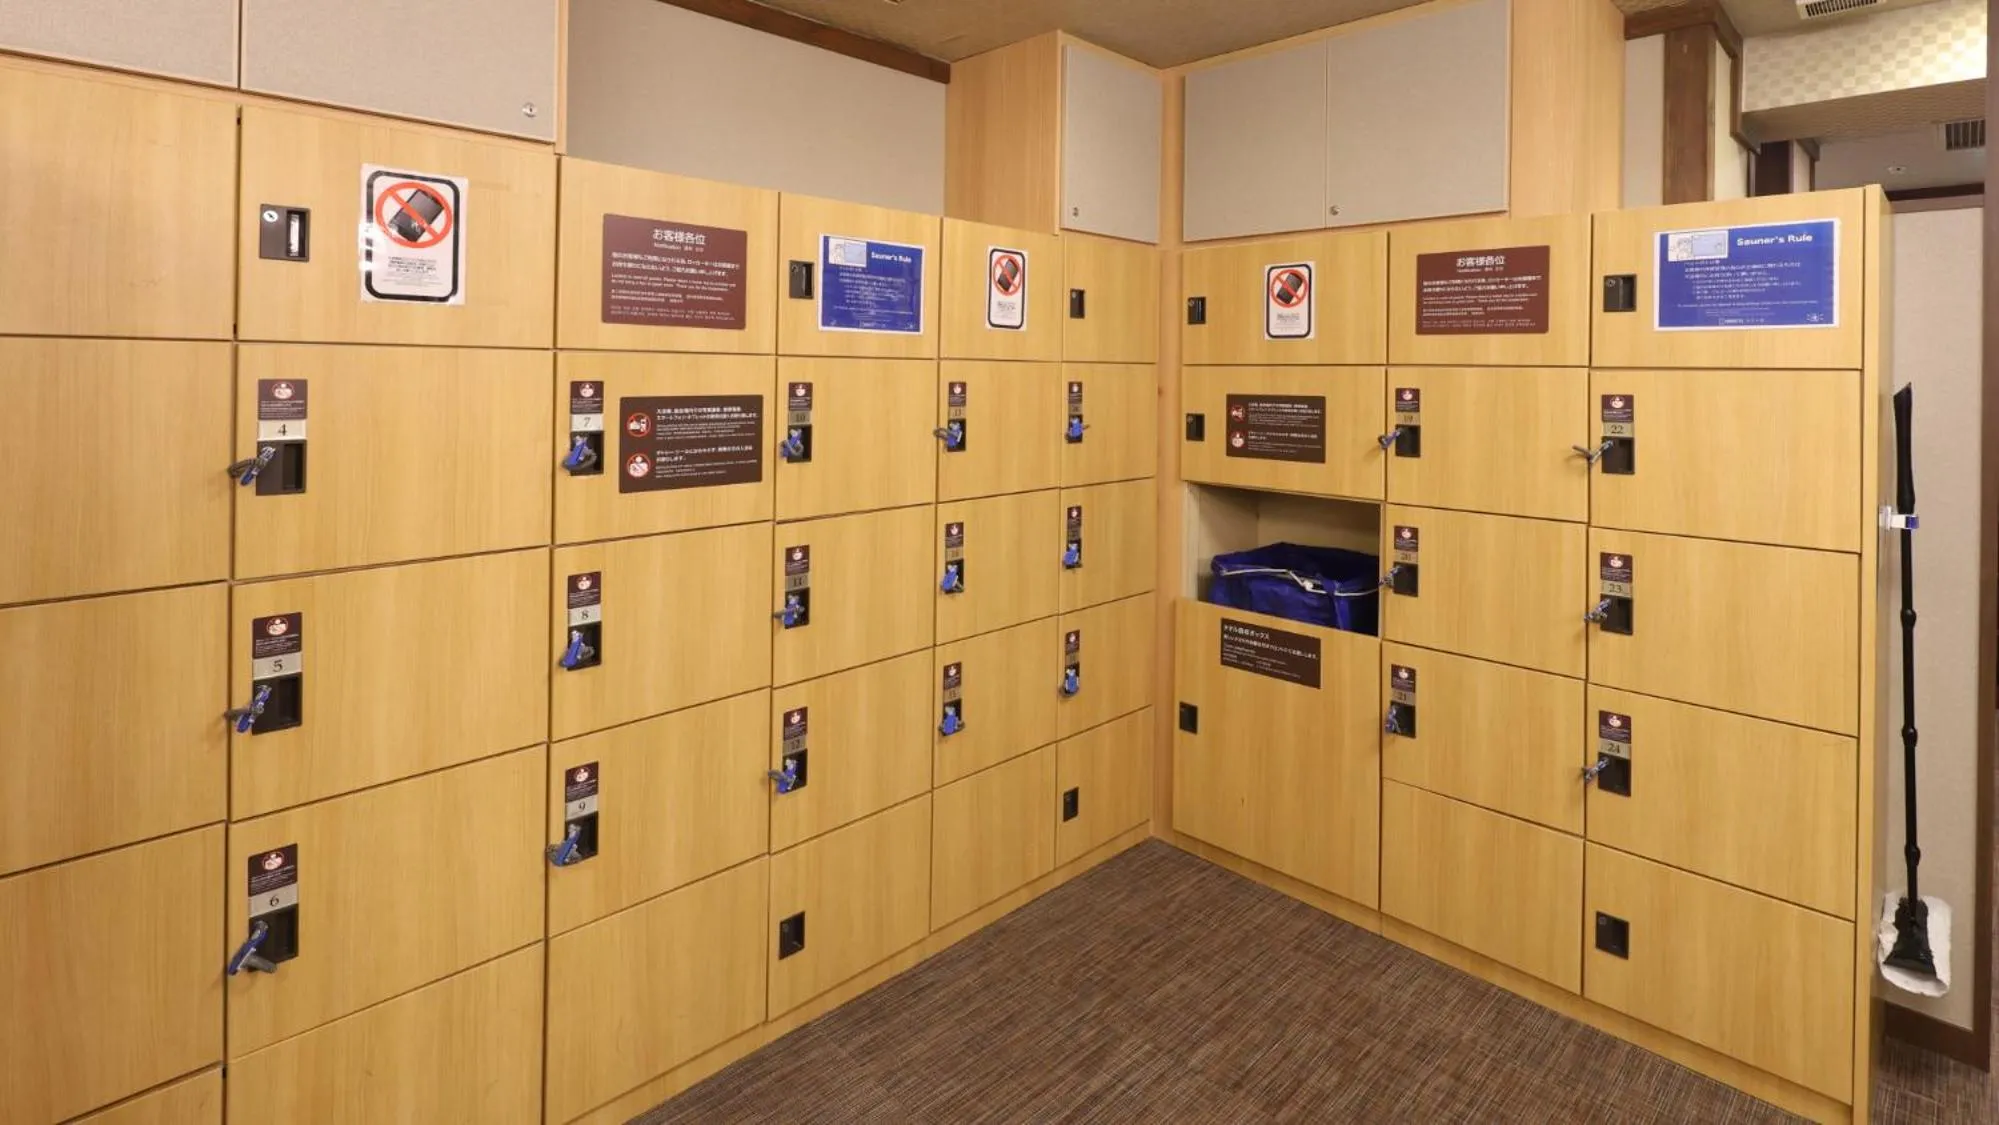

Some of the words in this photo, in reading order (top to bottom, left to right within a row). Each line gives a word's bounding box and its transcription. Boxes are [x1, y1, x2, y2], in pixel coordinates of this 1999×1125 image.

[653, 228, 706, 245] お客様各位
[1736, 236, 1785, 246] Sauner's
[1788, 233, 1813, 243] Rule
[1456, 255, 1505, 267] お客様各位
[583, 416, 591, 427] 7
[278, 424, 287, 436] 4
[1610, 425, 1624, 434] 22
[1609, 583, 1622, 593] 23
[581, 610, 589, 620] 8
[273, 659, 283, 672] 5
[1607, 743, 1620, 754] 24
[578, 801, 586, 811] 9
[270, 895, 279, 907] 6
